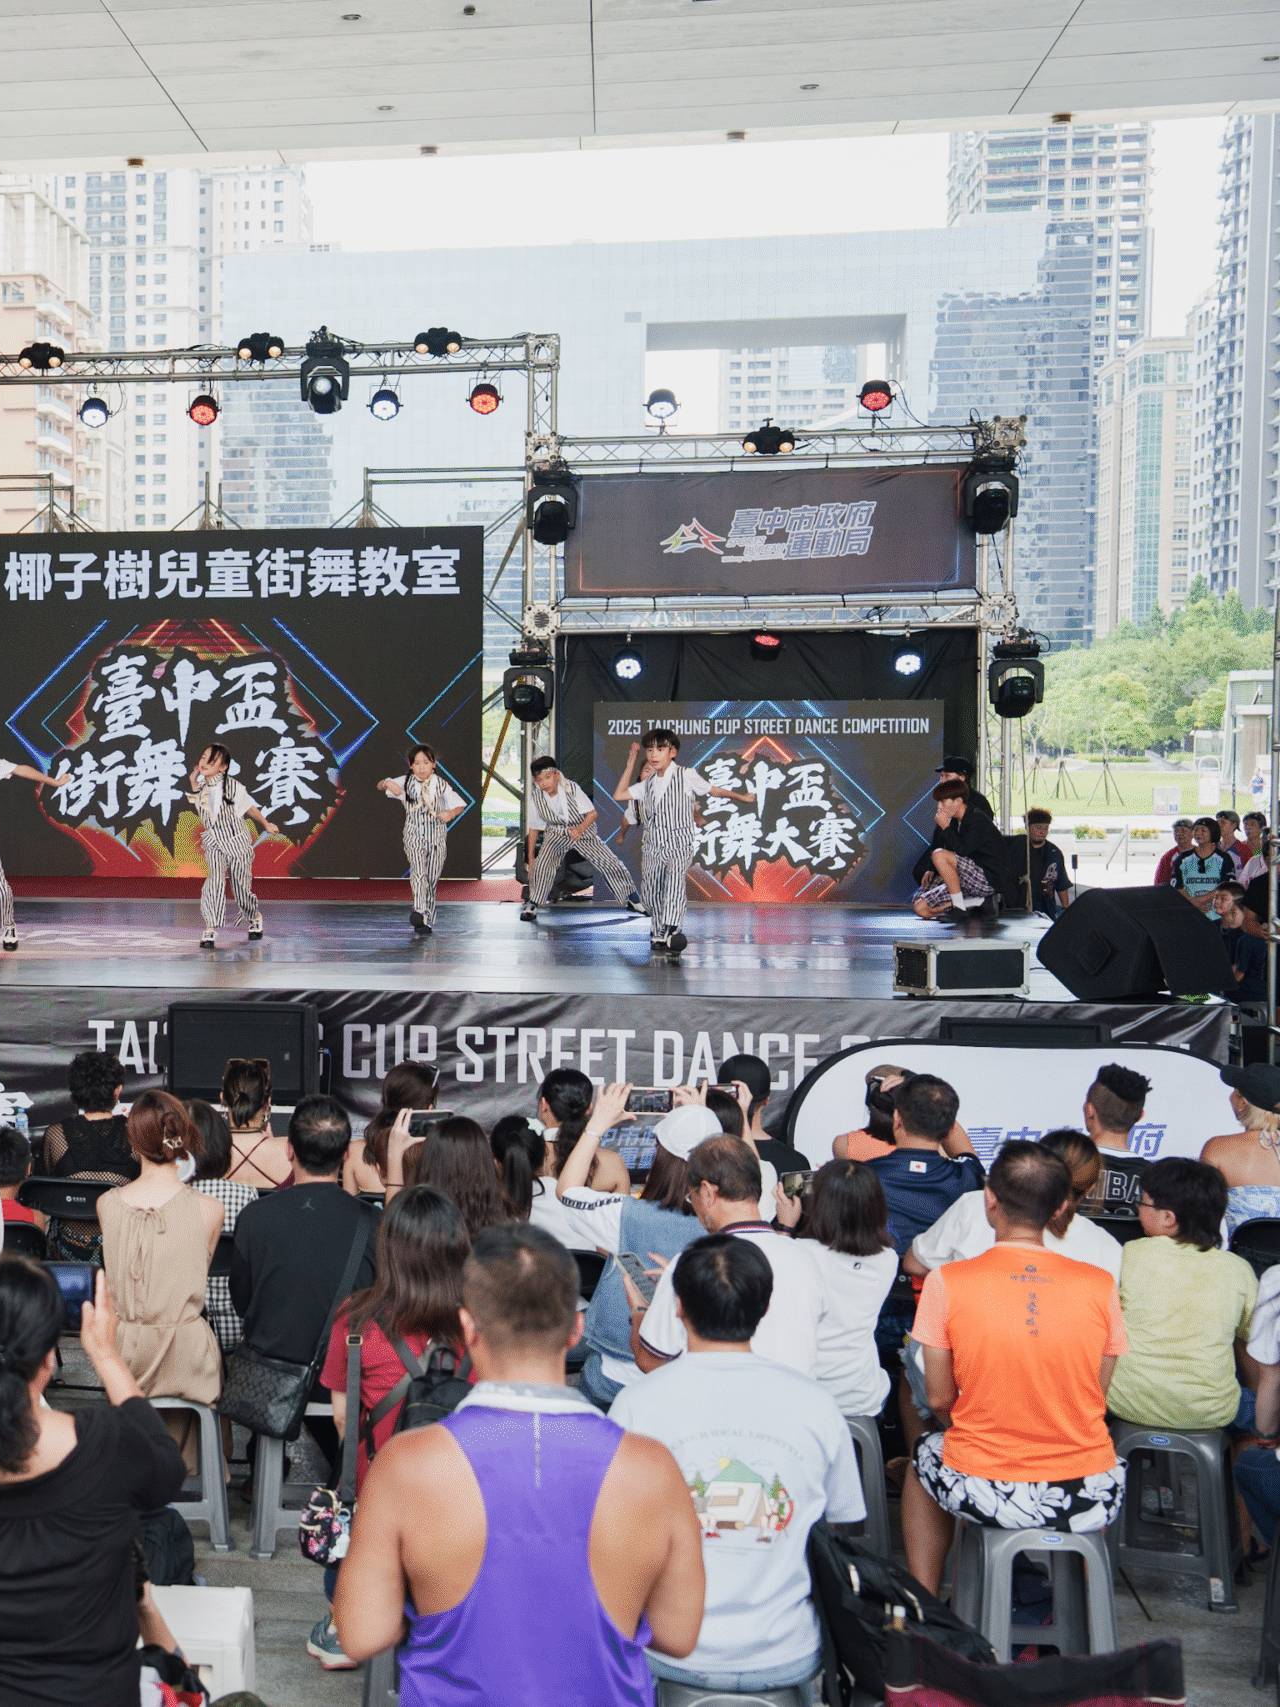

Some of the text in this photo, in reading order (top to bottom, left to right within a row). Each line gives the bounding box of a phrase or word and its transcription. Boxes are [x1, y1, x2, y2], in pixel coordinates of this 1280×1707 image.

[728, 501, 877, 537] 臺中市政府
[782, 527, 874, 560] 運動局
[4, 545, 461, 601] 椰子樹兒童街舞教室
[93, 655, 289, 747] 臺中盃
[608, 718, 930, 735] 2025 TAICHUNG CUP STREET DANCE COMPETITION
[51, 736, 324, 826] 街舞賽
[703, 758, 833, 820] 臺中盃
[343, 1023, 437, 1079] CUP
